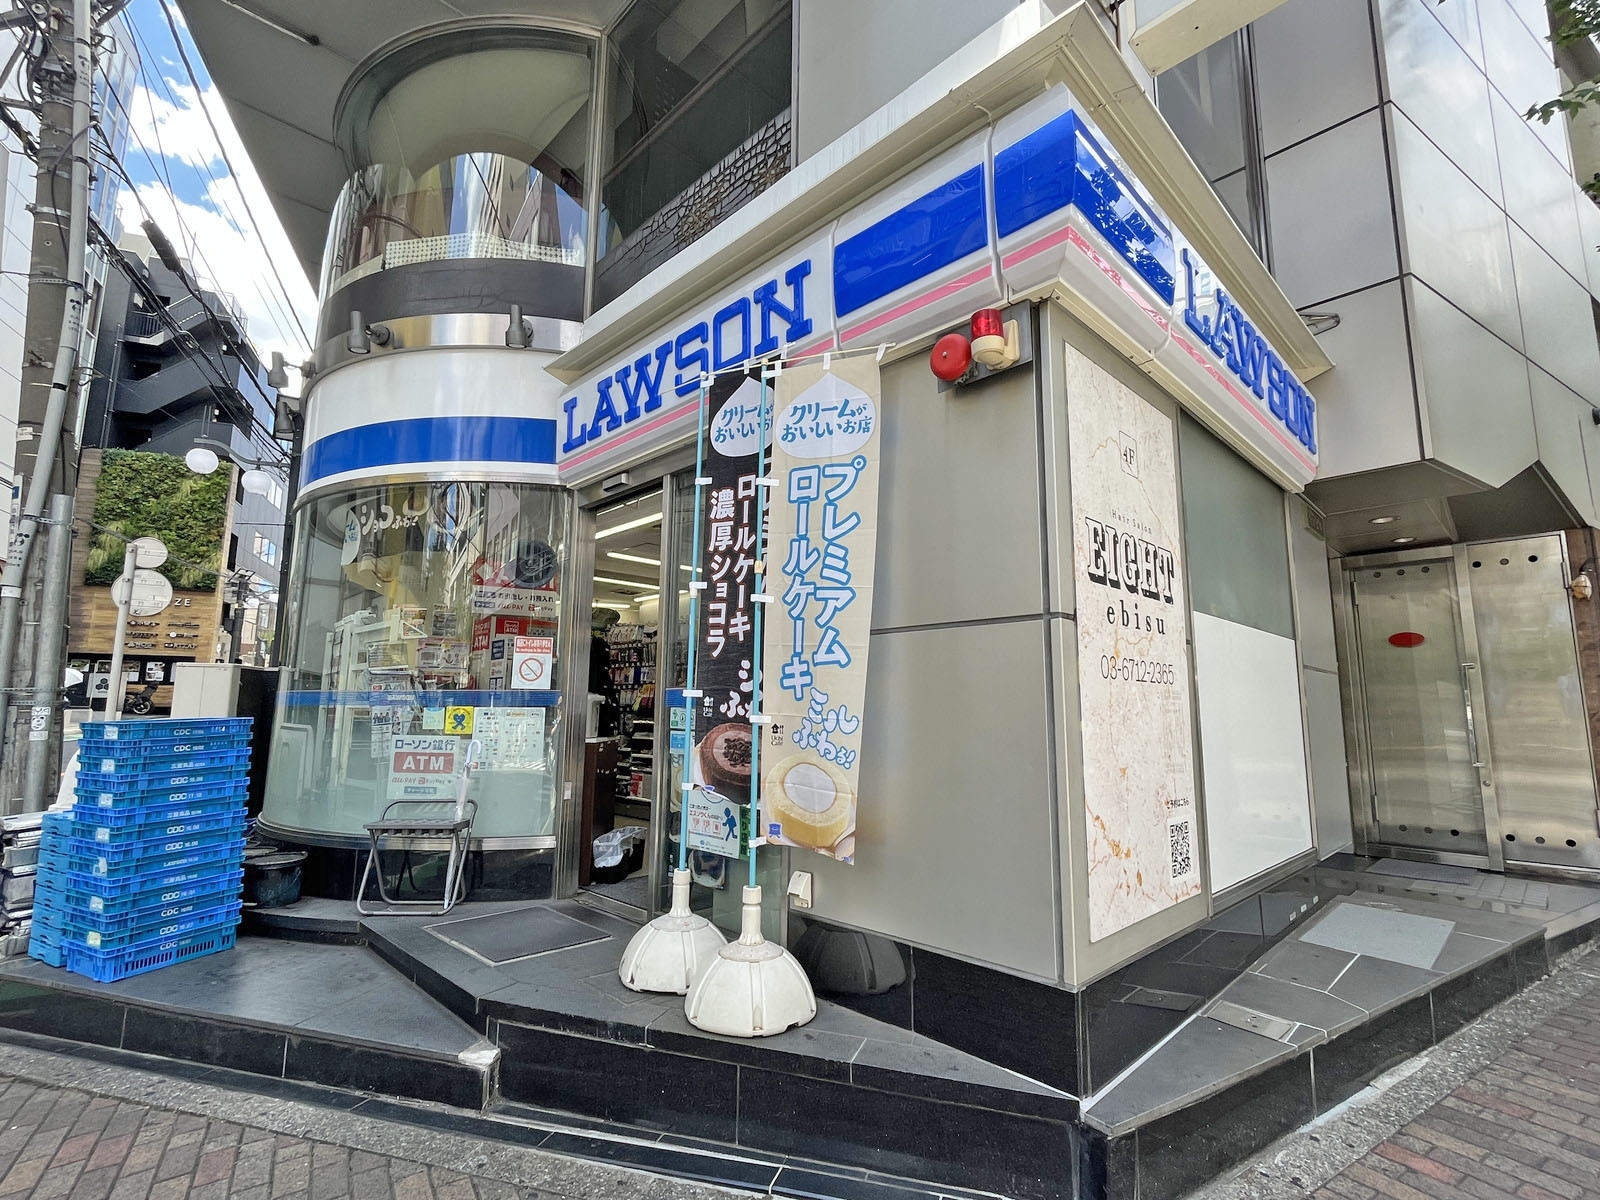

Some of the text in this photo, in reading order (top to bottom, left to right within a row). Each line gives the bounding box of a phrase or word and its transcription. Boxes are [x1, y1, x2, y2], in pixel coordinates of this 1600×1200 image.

[563, 259, 813, 453] LAWSON
[1180, 248, 1317, 455] LAWSON
[790, 399, 867, 424] クリームが
[781, 416, 872, 443] おいしいお店
[1123, 446, 1135, 465] 4F
[729, 474, 757, 642] ロールケーキ
[813, 455, 867, 668] プレミアム
[1085, 516, 1174, 605] EIGHT
[707, 488, 736, 658] 濃厚ショコラ
[780, 465, 820, 701] ロールケーキ
[1106, 599, 1165, 635] ebisu
[1100, 654, 1174, 685] 03-6712-2365
[808, 687, 859, 735] ミル
[395, 739, 455, 751] ローソン銀行
[402, 756, 444, 771] ATM
[169, 792, 187, 801] CDC
[167, 825, 185, 834] CDC
[165, 842, 183, 850] CDC
[161, 892, 180, 901] CDC
[161, 908, 179, 917] CDC
[160, 925, 178, 935] CDC
[160, 941, 178, 951] CDC
